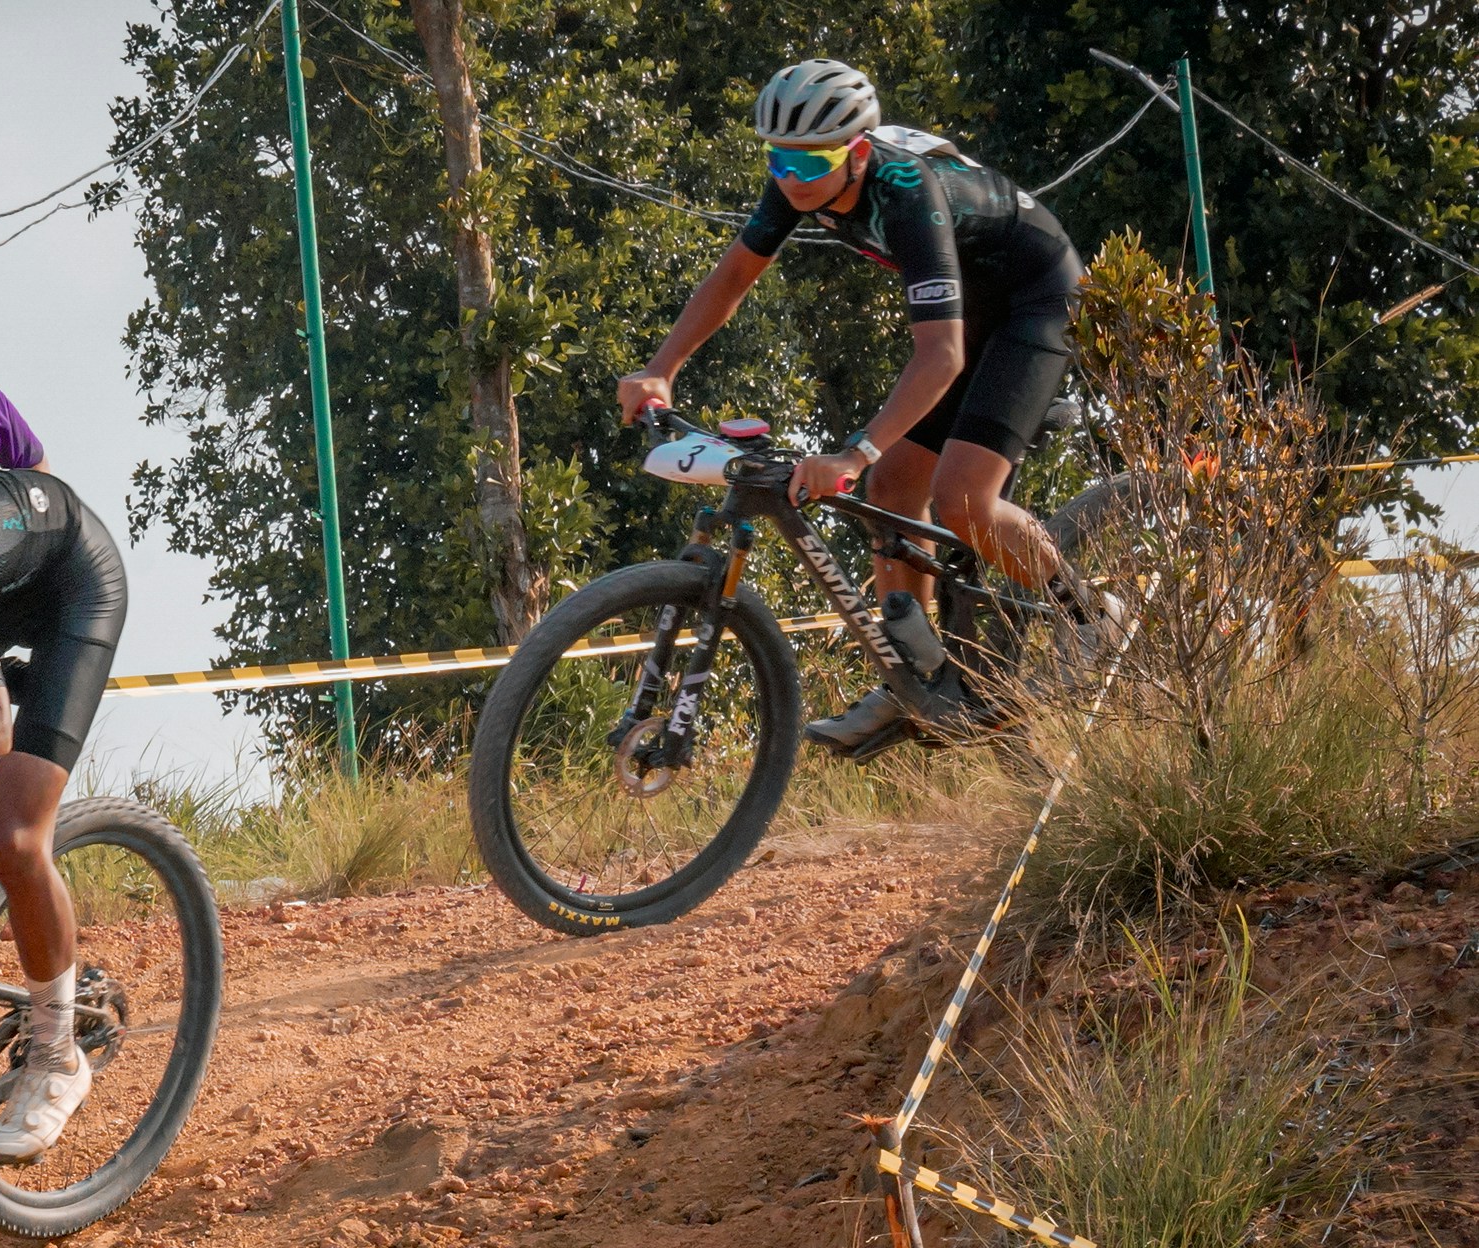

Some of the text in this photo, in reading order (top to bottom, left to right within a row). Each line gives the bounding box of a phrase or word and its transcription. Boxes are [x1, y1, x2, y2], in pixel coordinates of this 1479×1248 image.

[915, 283, 955, 299] 100%
[678, 444, 707, 473] 3
[796, 534, 905, 670] SANTA CRUZ
[667, 688, 699, 736] FOX
[548, 901, 621, 927] MAXXIS
